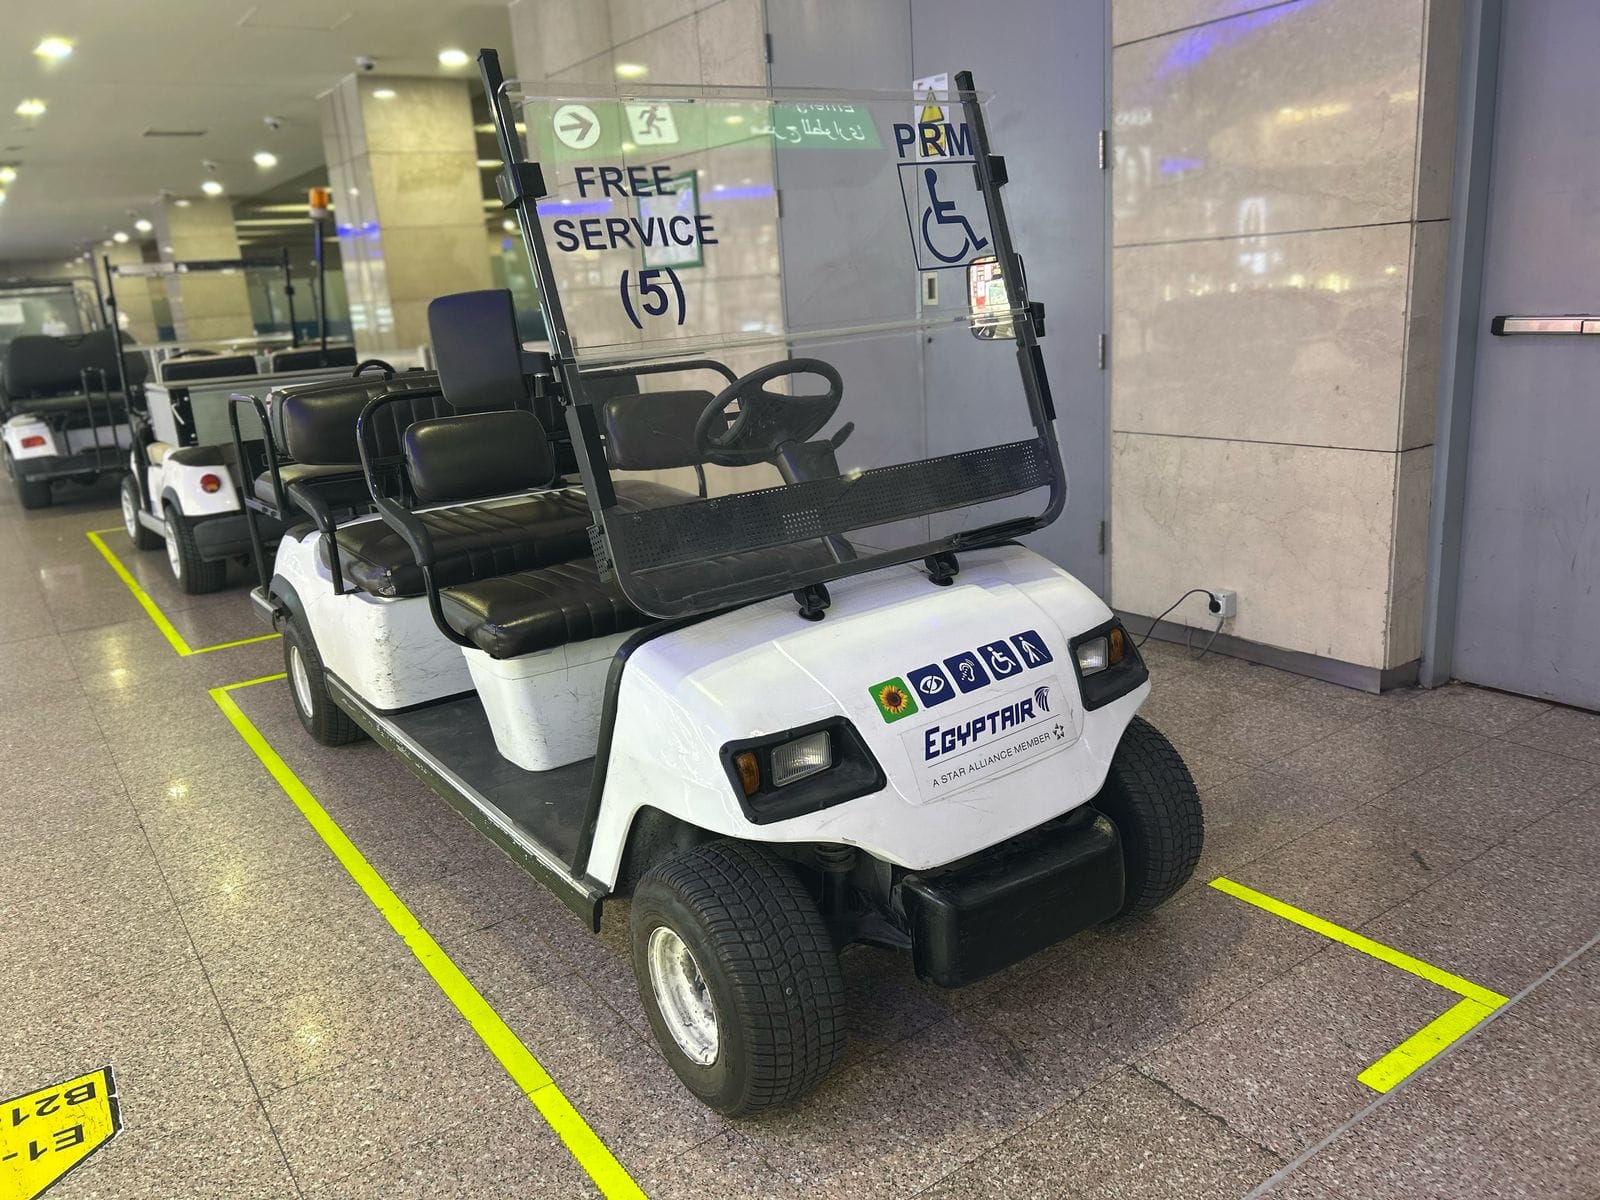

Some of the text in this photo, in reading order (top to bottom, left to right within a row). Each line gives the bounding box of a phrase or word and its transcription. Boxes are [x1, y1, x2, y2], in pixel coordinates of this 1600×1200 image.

[893, 122, 975, 158] PRM
[574, 166, 677, 198] FREE
[553, 215, 719, 252] SERVICE
[620, 267, 686, 329] (5)
[924, 698, 1037, 761] EGYPTAIR
[932, 732, 1051, 788] A STAR ALLIANCE MEMBER
